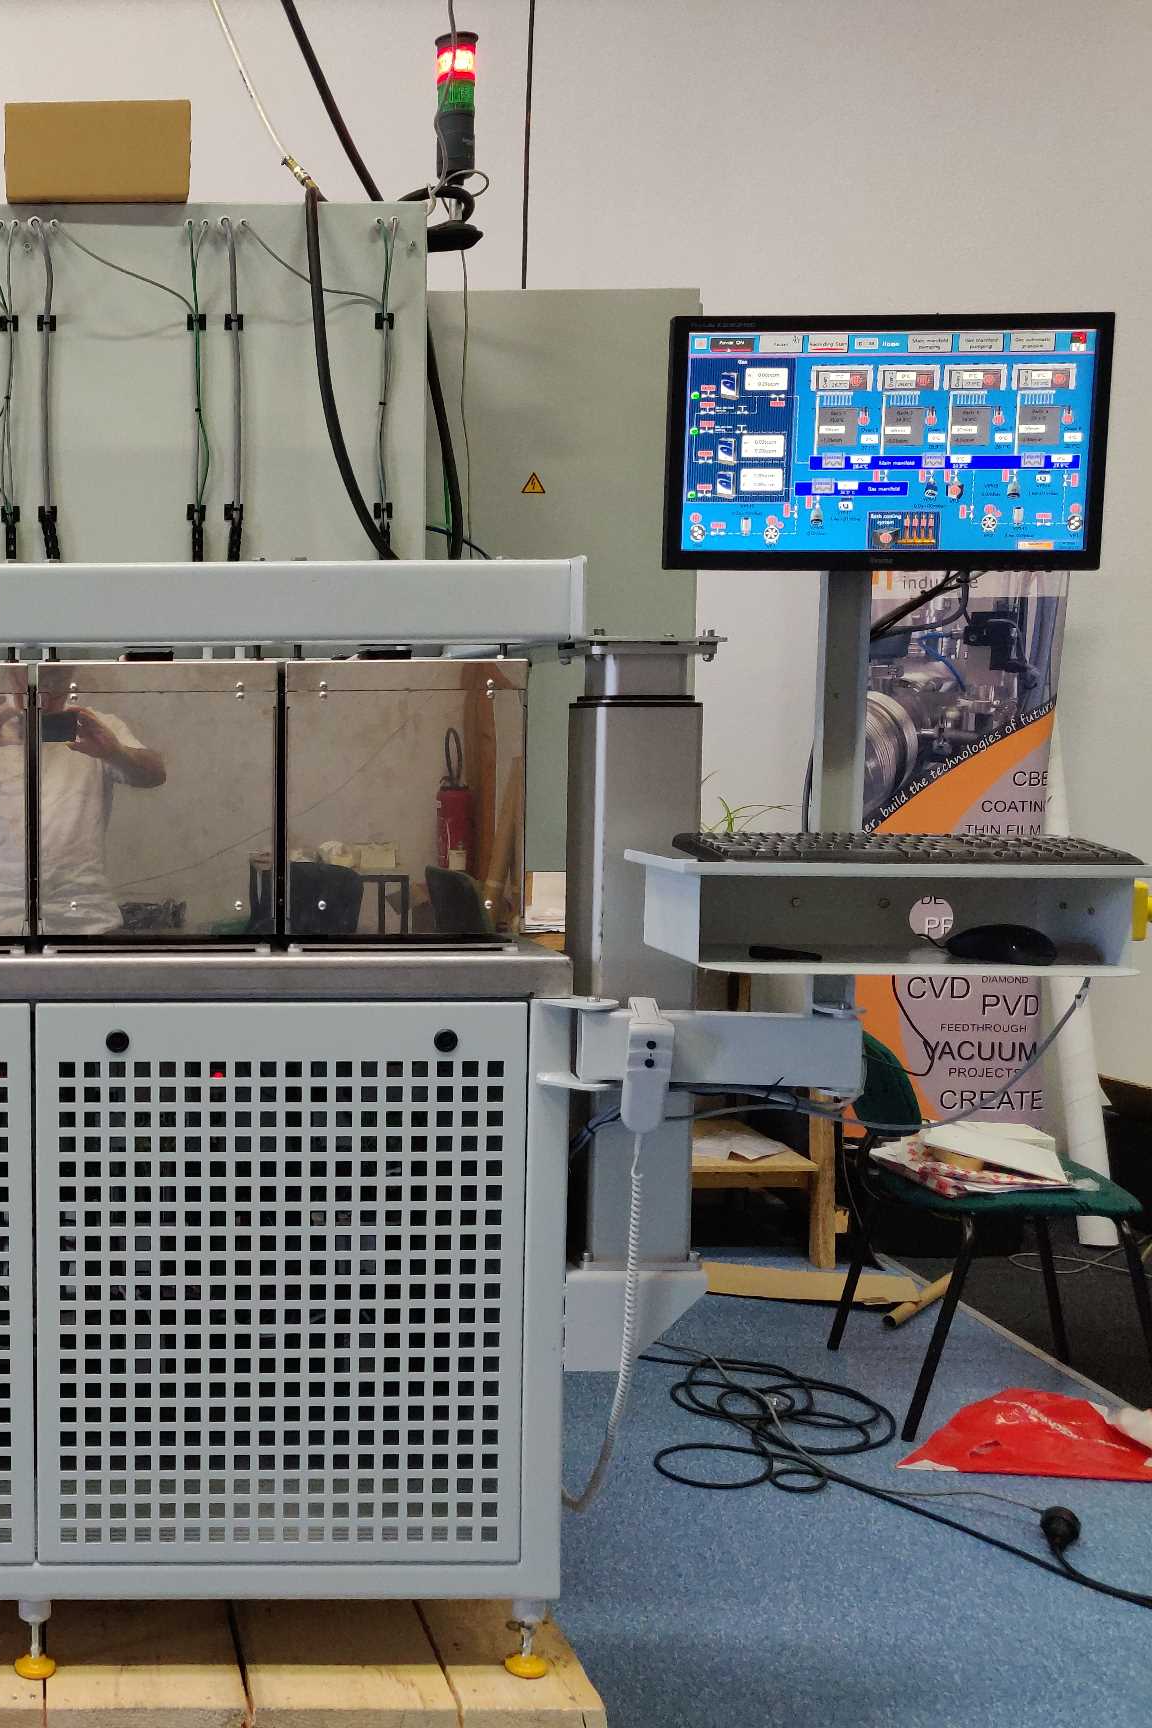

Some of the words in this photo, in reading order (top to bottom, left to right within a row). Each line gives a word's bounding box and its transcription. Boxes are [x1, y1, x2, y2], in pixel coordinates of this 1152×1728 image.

[879, 790, 909, 818] build
[909, 777, 929, 794] the
[929, 730, 1002, 780] technologies
[1005, 718, 1017, 734] of
[981, 800, 1046, 813] COATIN
[965, 824, 1001, 835] THIN
[907, 976, 970, 999] CVD
[981, 975, 1029, 984] DIAMOND
[981, 994, 1040, 1017] PVD
[940, 1023, 1027, 1033] FEEDTHROUGH
[922, 1040, 1038, 1061] VACUUM
[939, 1089, 1044, 1111] CREATE
